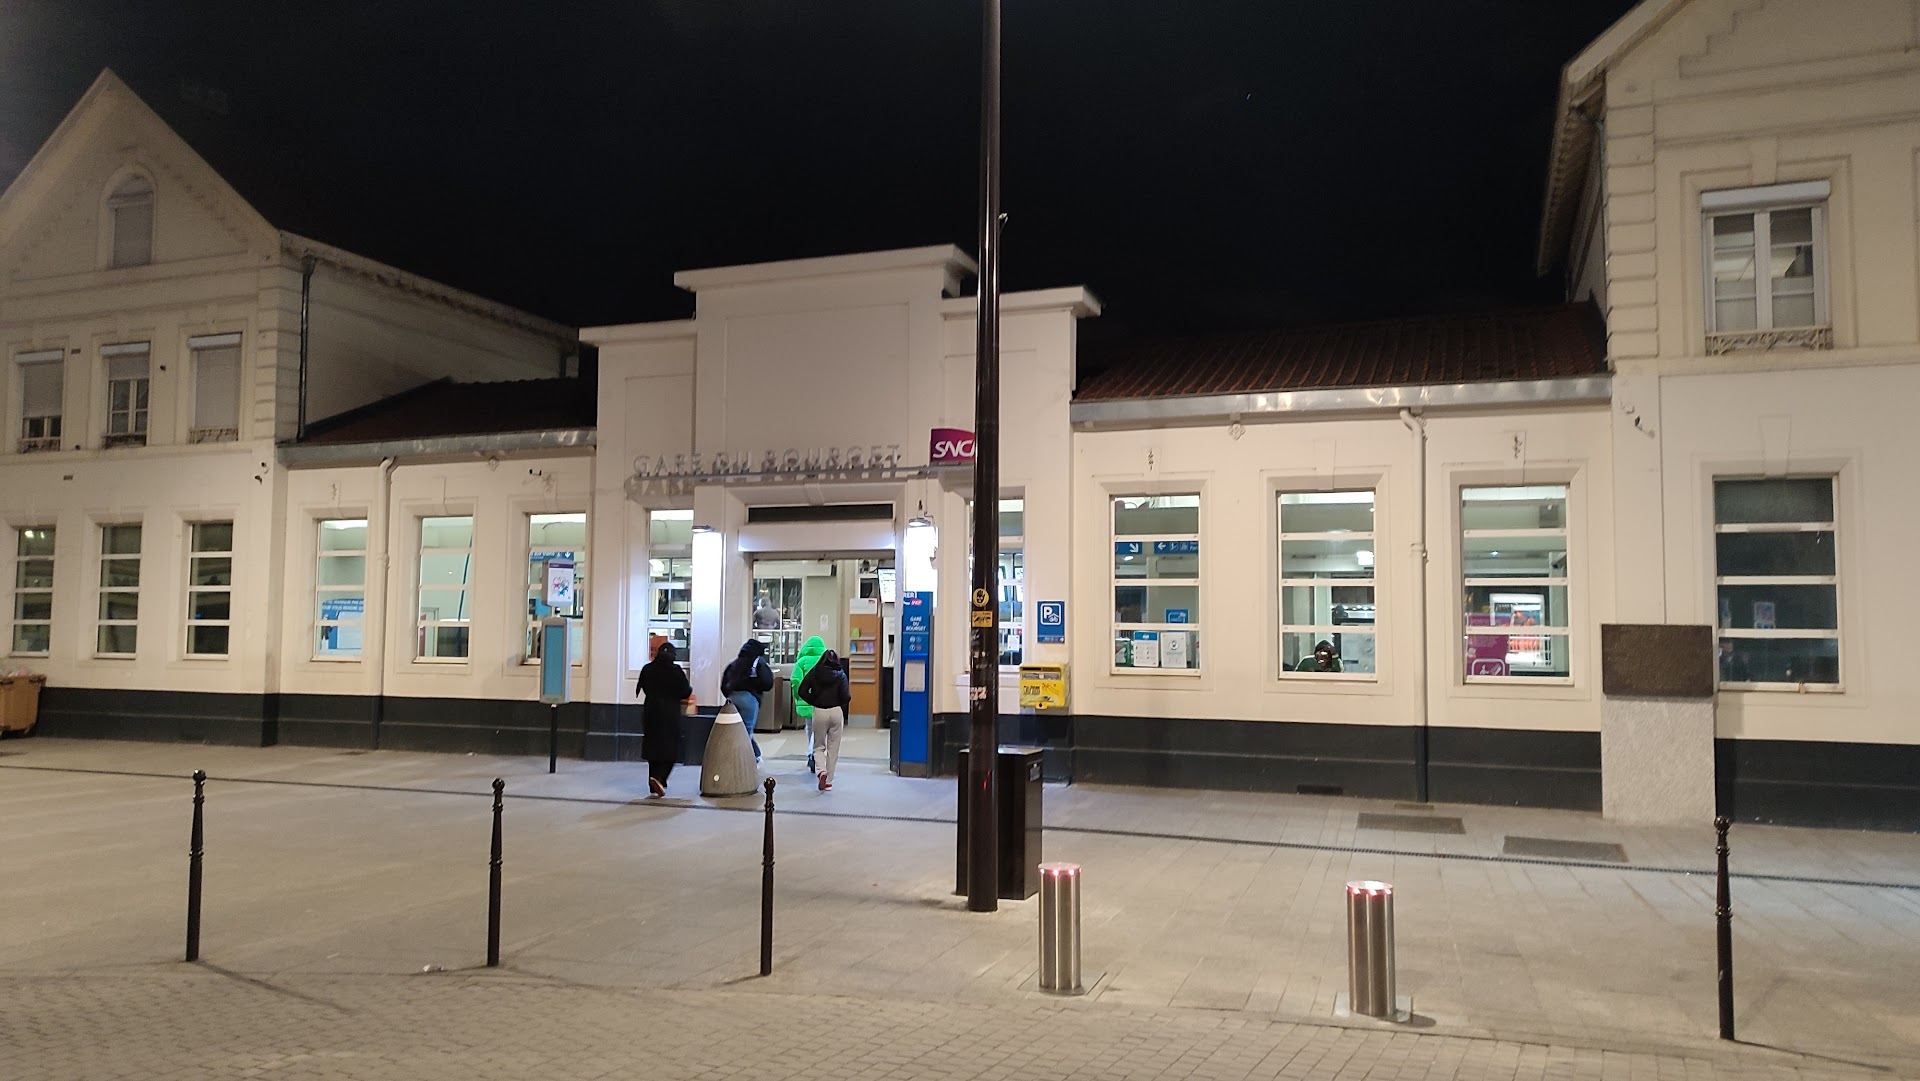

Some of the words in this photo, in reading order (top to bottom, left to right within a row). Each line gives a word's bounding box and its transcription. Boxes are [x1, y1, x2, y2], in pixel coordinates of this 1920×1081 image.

[632, 453, 703, 477] GARE
[713, 451, 751, 475] DU
[762, 444, 901, 473] BOURGET
